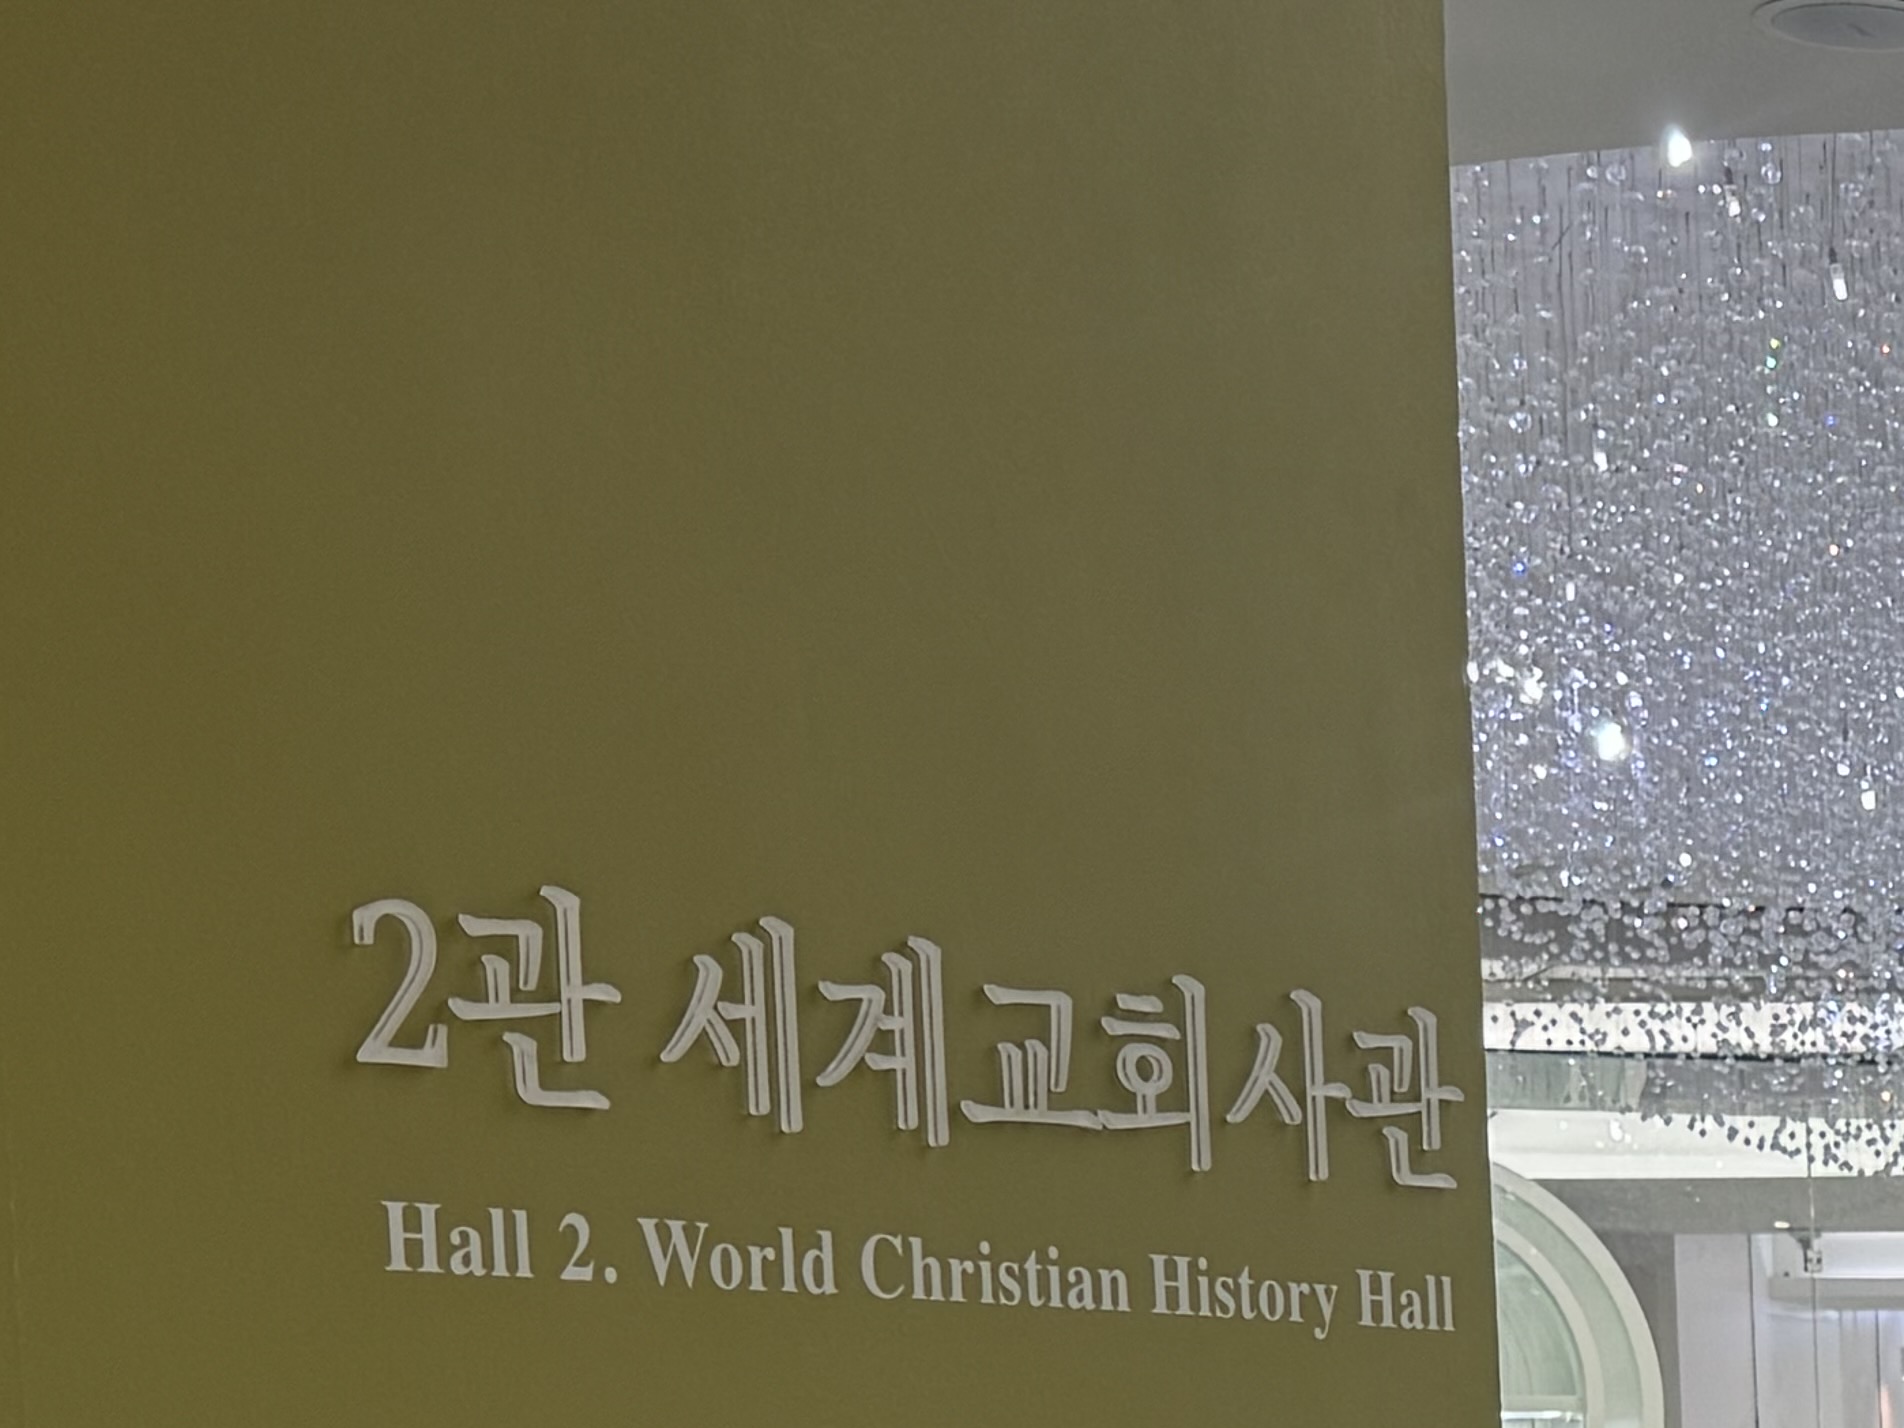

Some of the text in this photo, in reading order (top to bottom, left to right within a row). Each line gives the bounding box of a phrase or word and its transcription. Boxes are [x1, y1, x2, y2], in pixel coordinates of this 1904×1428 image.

[353, 885, 1464, 1188] 2관 세계교회사관
[382, 1201, 1456, 1340] Hall 2. World Christian History Hall
